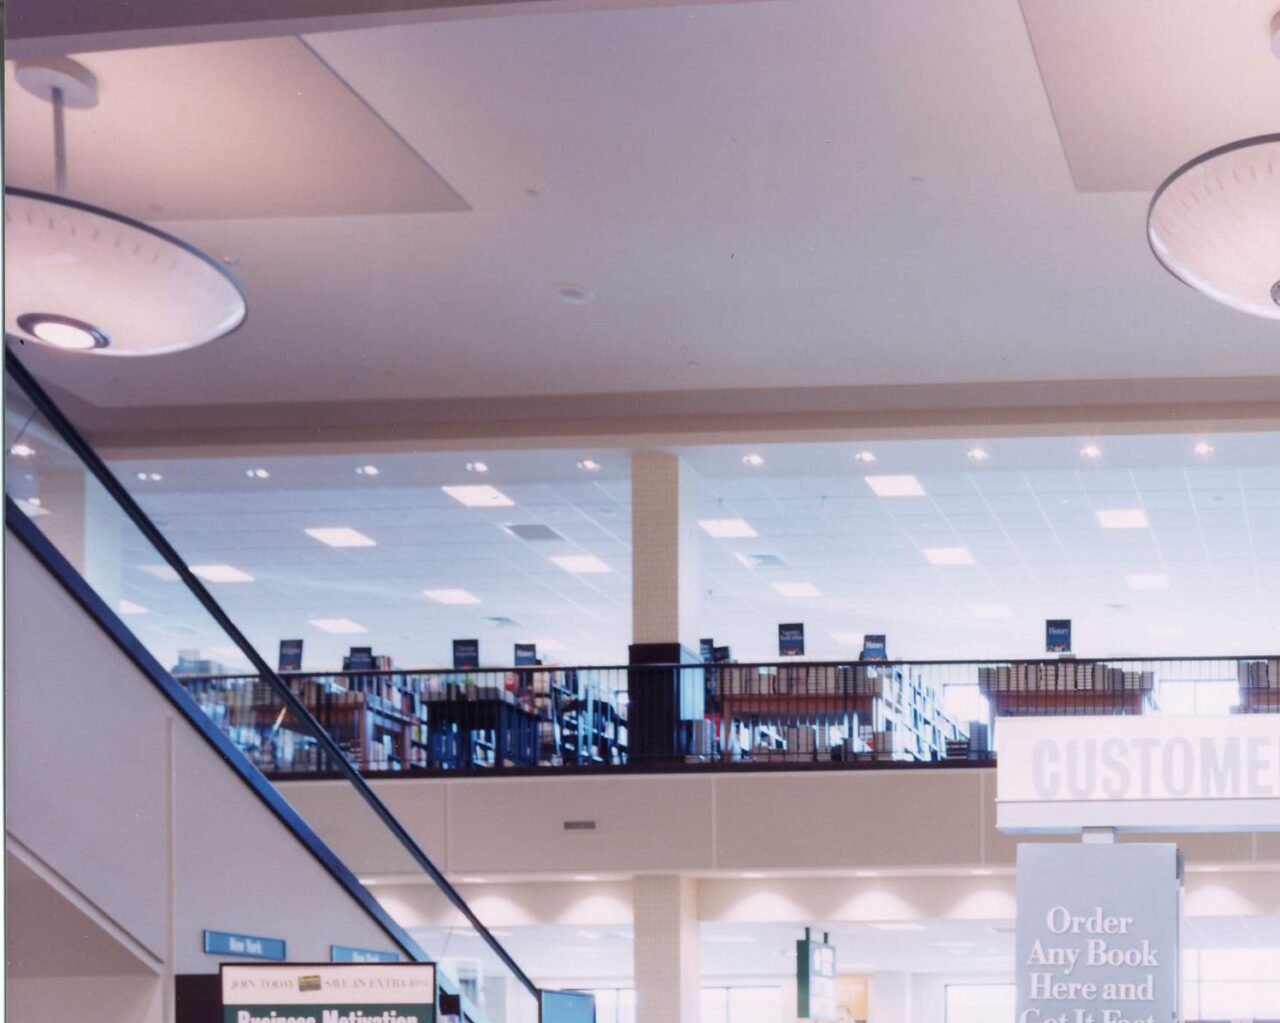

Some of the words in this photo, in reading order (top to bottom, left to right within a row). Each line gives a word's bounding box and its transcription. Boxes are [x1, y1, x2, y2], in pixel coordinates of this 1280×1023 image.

[1045, 906, 1133, 934] Order
[1026, 940, 1080, 974] Any
[1084, 939, 1160, 967] Book
[1029, 973, 1097, 1000] Here
[1101, 973, 1155, 1001] and
